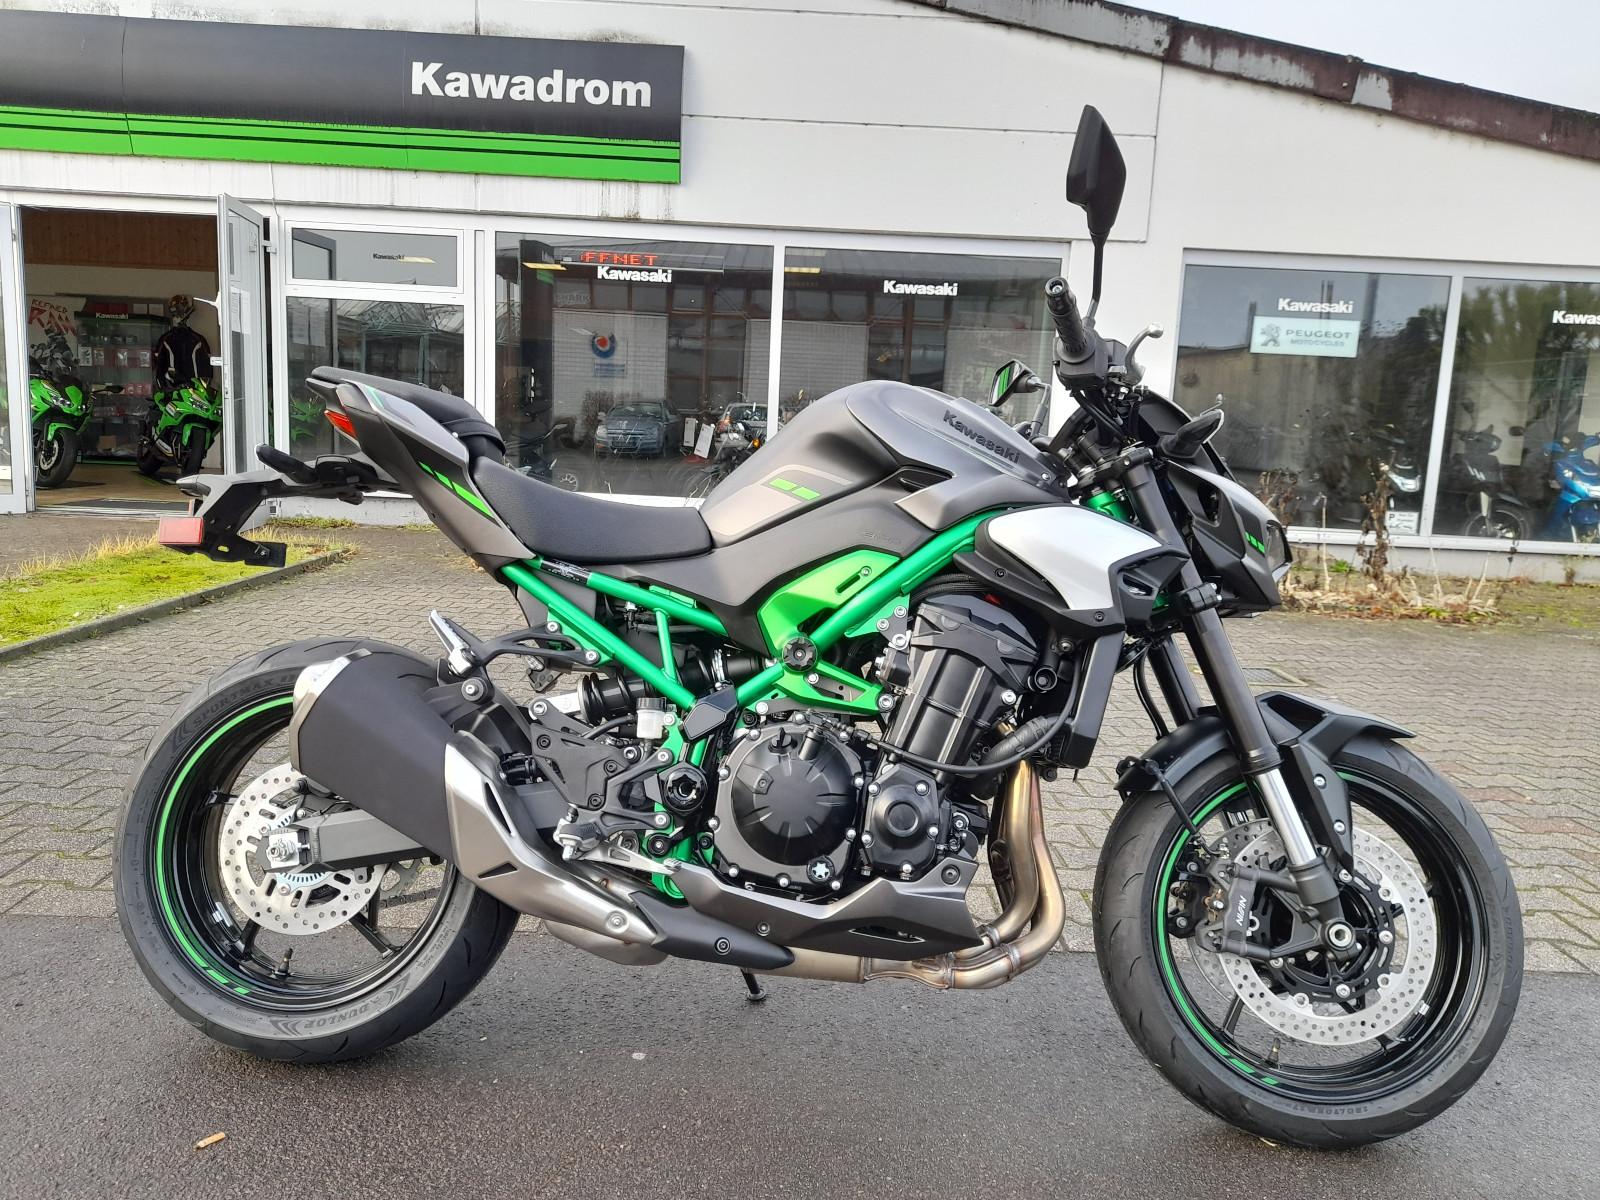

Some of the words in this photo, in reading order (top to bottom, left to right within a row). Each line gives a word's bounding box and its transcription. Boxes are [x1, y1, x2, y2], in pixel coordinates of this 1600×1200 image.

[411, 61, 652, 107] Kawadrom
[597, 266, 672, 283] Kawasaki
[883, 280, 959, 296] Kawasaki
[1278, 298, 1354, 314] Kawasaki
[1286, 329, 1352, 339] PEUGEOT
[943, 409, 1020, 465] Kawasaki
